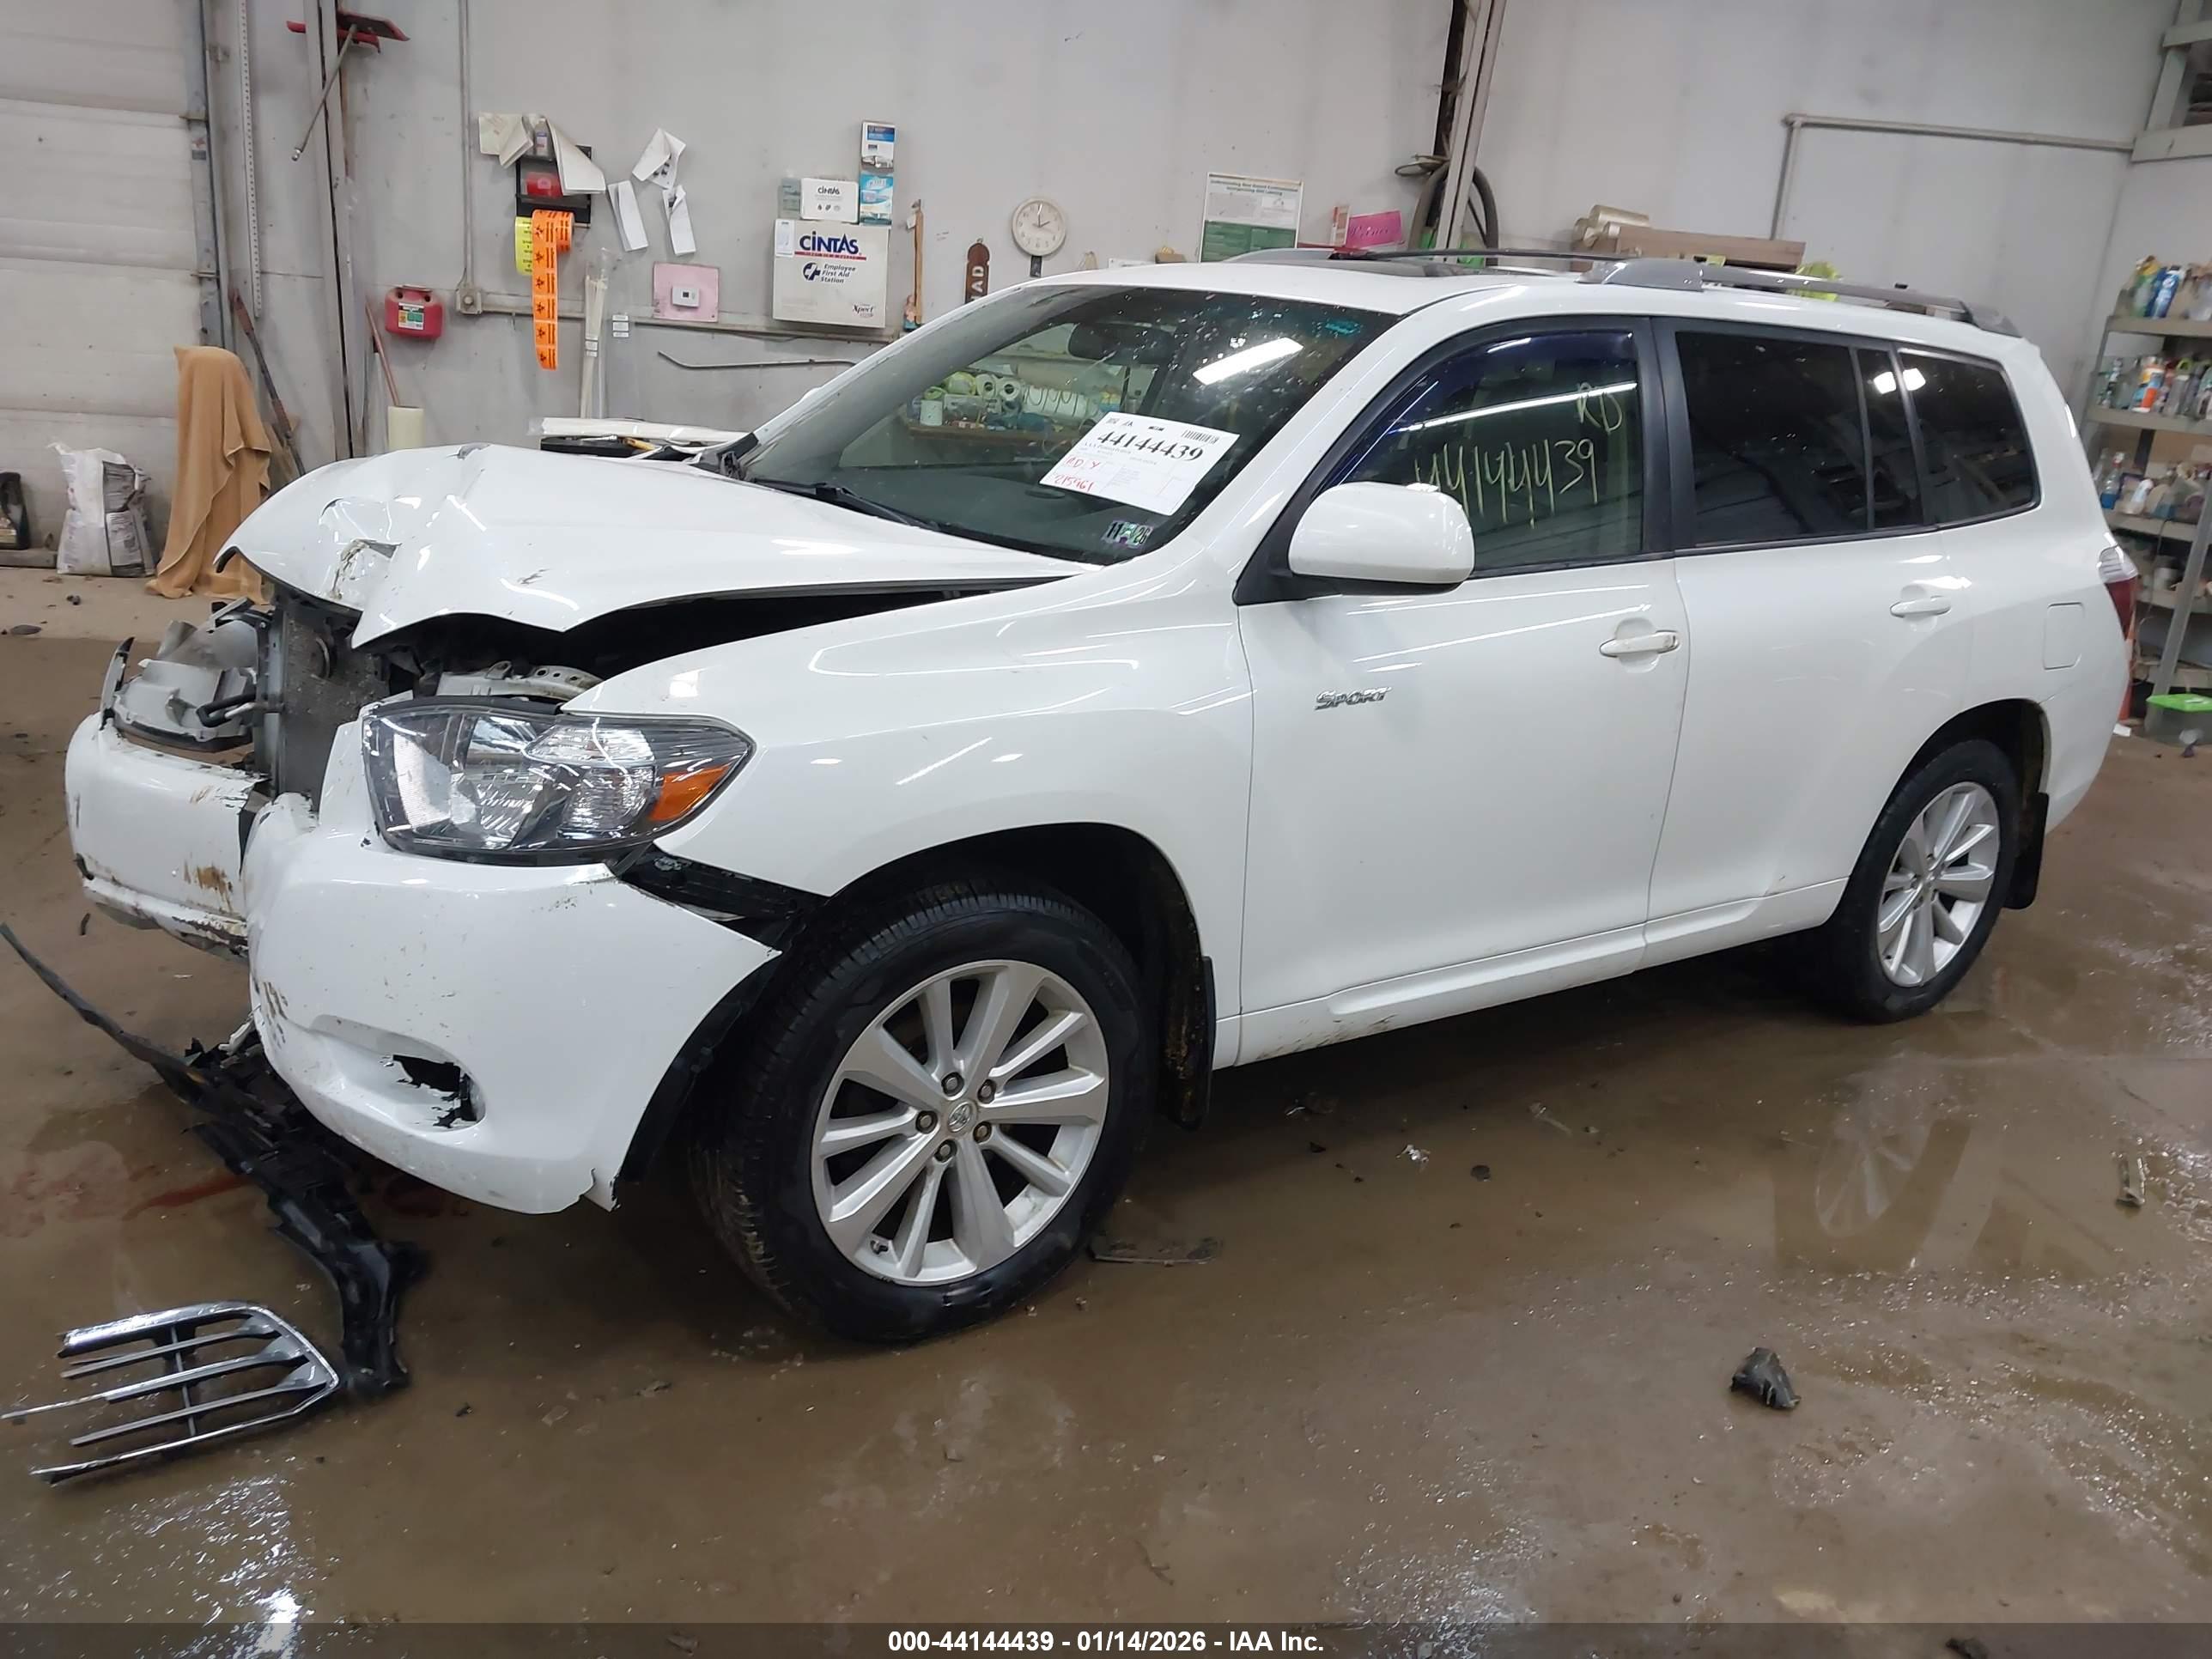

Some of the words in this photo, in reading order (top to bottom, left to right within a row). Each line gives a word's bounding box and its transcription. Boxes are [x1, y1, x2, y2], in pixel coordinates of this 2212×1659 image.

[799, 231, 859, 255] CINTAS
[823, 264, 856, 272] Employee
[1097, 431, 1204, 461] 44144439
[1315, 687, 1392, 711] SPORT
